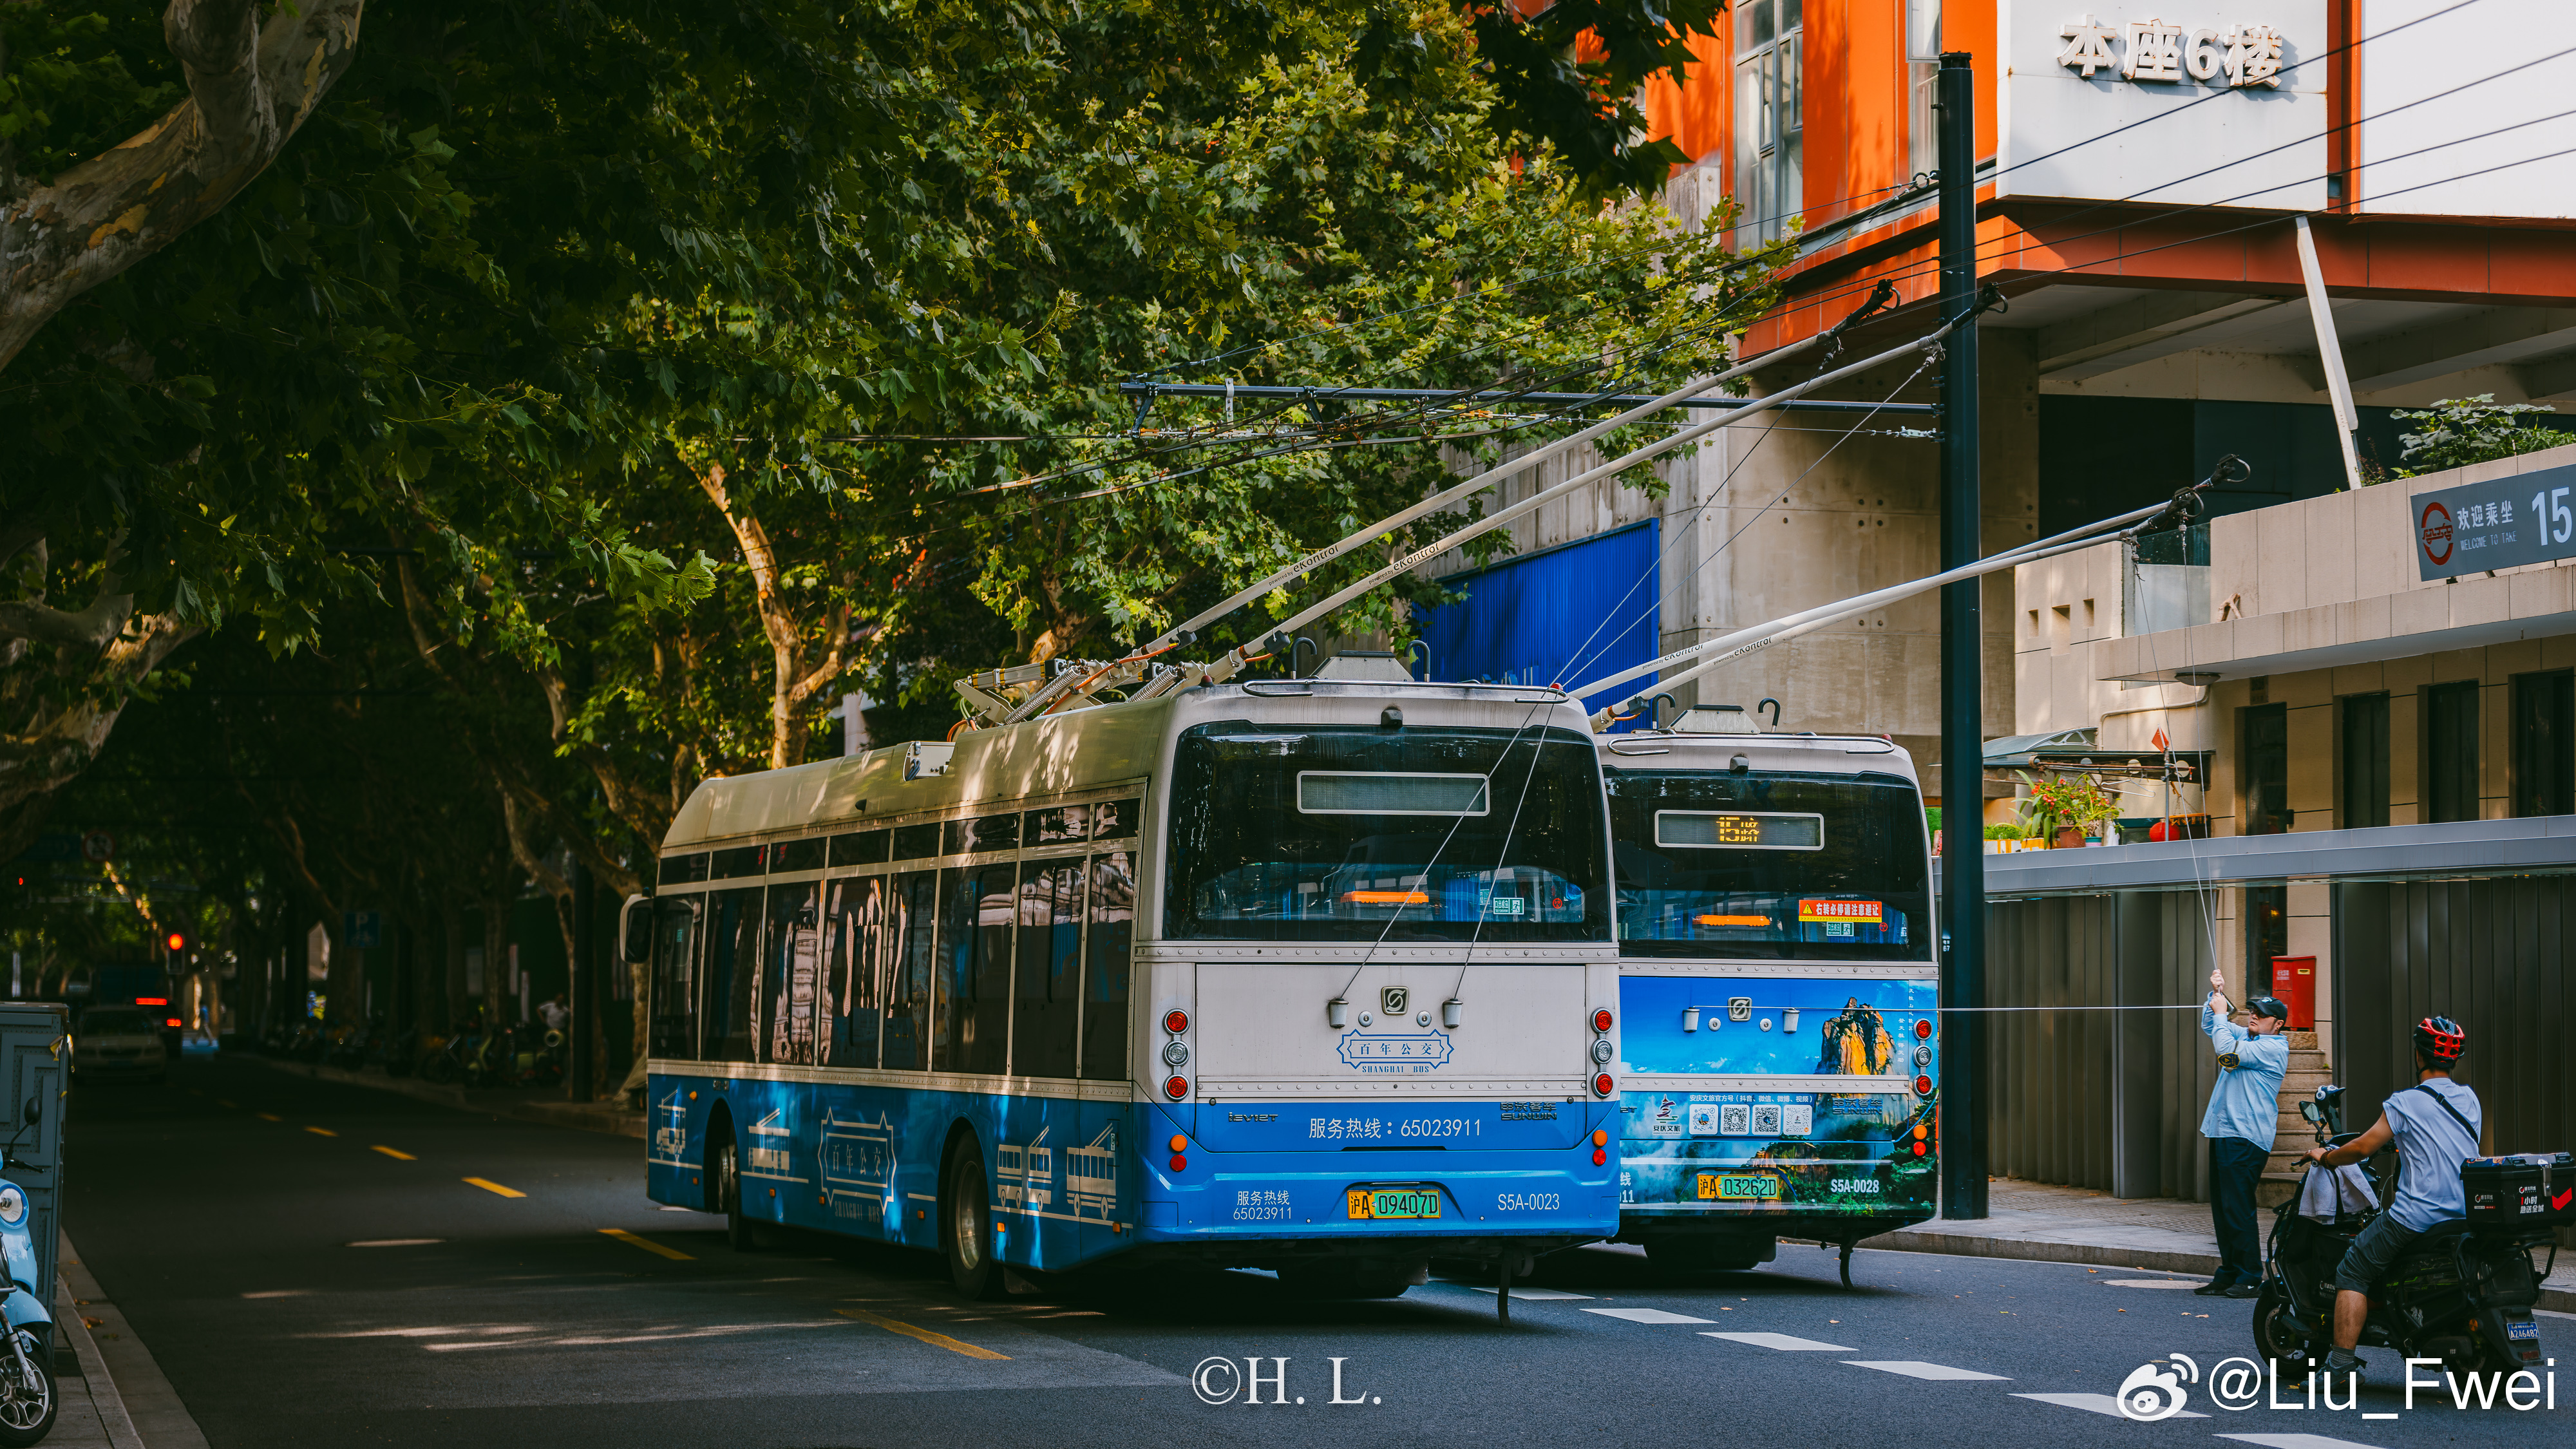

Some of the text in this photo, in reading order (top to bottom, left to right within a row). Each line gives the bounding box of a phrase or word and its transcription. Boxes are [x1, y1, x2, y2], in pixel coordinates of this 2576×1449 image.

[2058, 14, 2283, 89] 本座6楼
[2456, 500, 2514, 531] 欢迎乘坐
[2532, 486, 2573, 546] 15
[2460, 531, 2517, 551] WELCOME TO TAKE
[1268, 572, 1287, 587] powered
[1368, 571, 1388, 585] powered
[1642, 660, 1659, 670] powered
[1713, 656, 1730, 666] powered
[1816, 903, 1879, 916] 右转必停请注意避让
[1359, 1043, 1432, 1056] 百年公交
[1500, 1101, 1557, 1112] 申沃客车
[1832, 1098, 1883, 1108] 申沃客车
[1501, 1112, 1557, 1121] SUNWIN
[832, 1144, 881, 1177] 百年公交
[1830, 1179, 1880, 1194] S5A-0028
[1236, 1189, 1290, 1206] 服务热线
[1497, 1193, 1560, 1211] S5A-0023
[1620, 1189, 1634, 1203] 11
[2521, 1196, 2537, 1206] 1小时
[868, 1206, 880, 1224] BUS
[1233, 1207, 1291, 1220] 65023911
[2510, 1329, 2539, 1339] A246482
